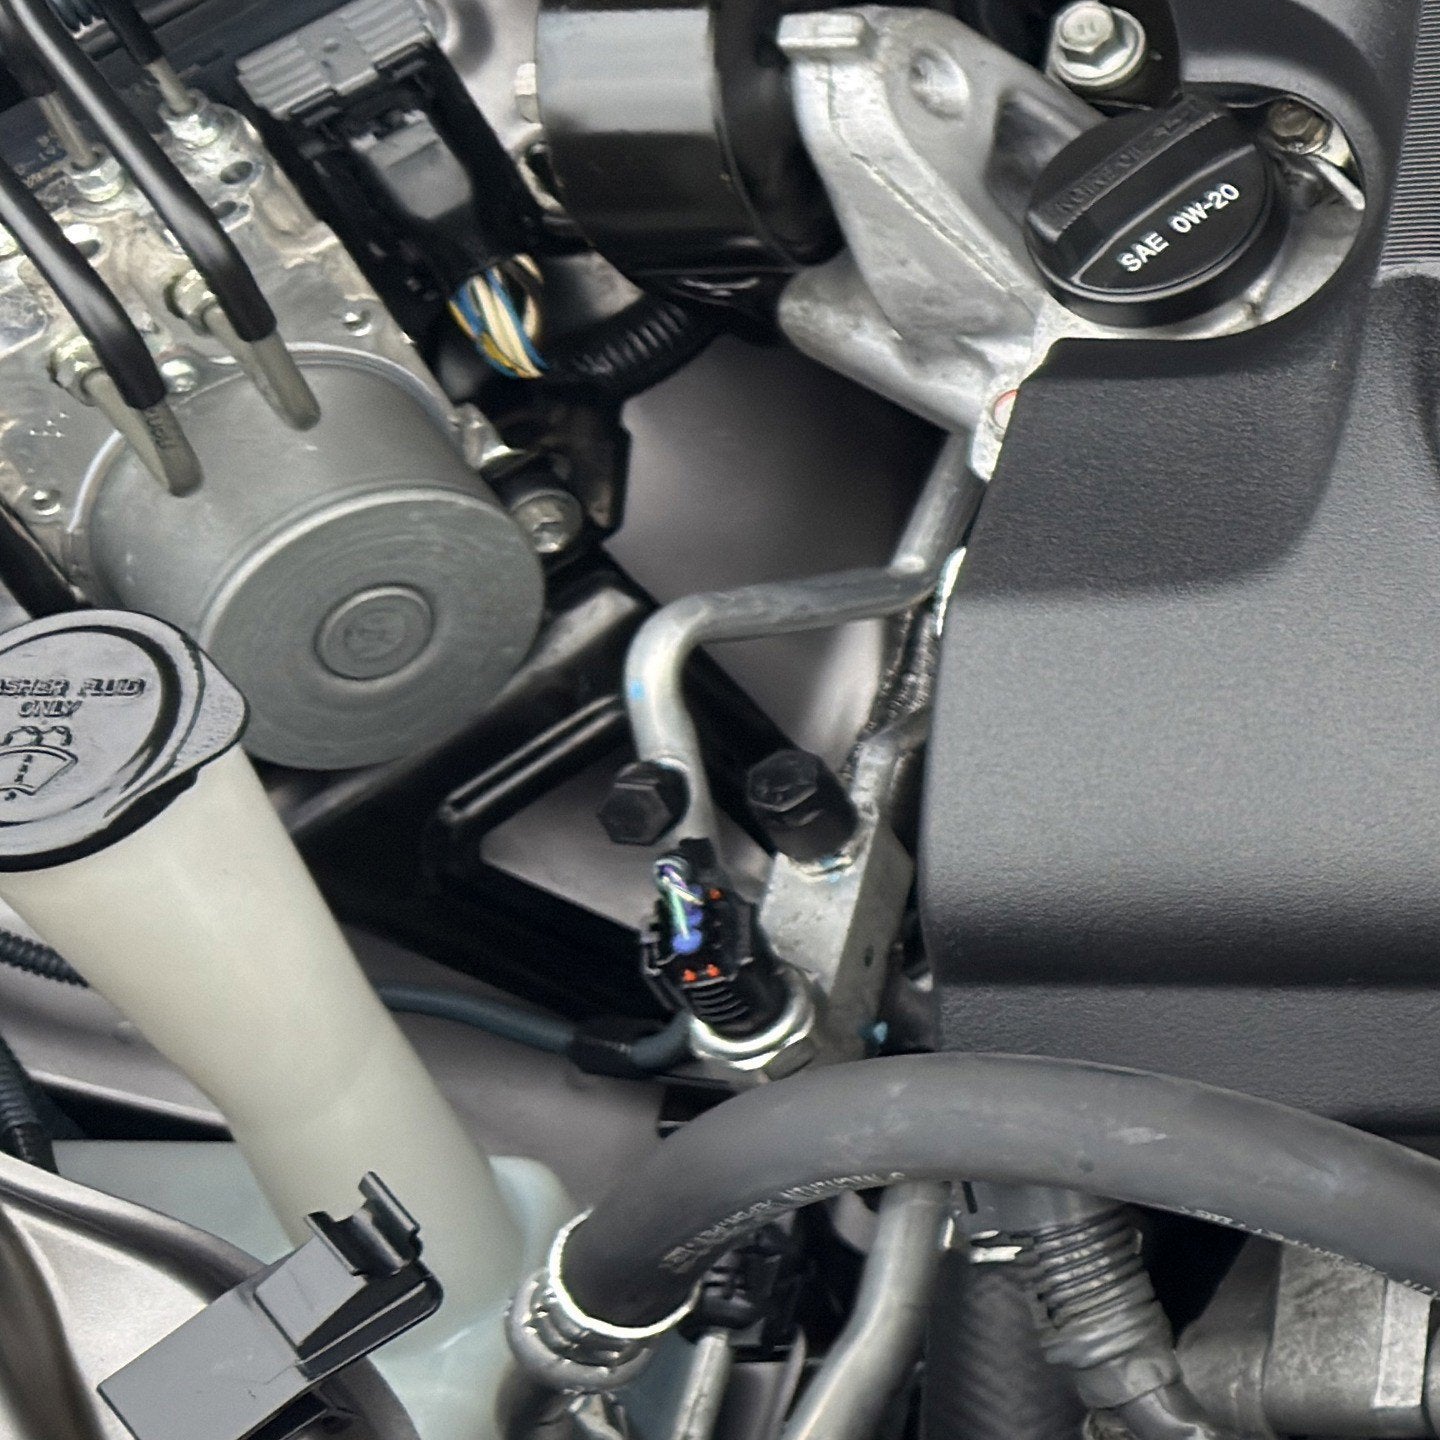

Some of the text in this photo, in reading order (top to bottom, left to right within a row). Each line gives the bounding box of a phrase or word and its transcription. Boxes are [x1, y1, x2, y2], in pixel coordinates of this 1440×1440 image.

[1118, 182, 1240, 273] SAE 0W-20
[77, 678, 147, 697] FLUID
[18, 699, 83, 718] ONLY
